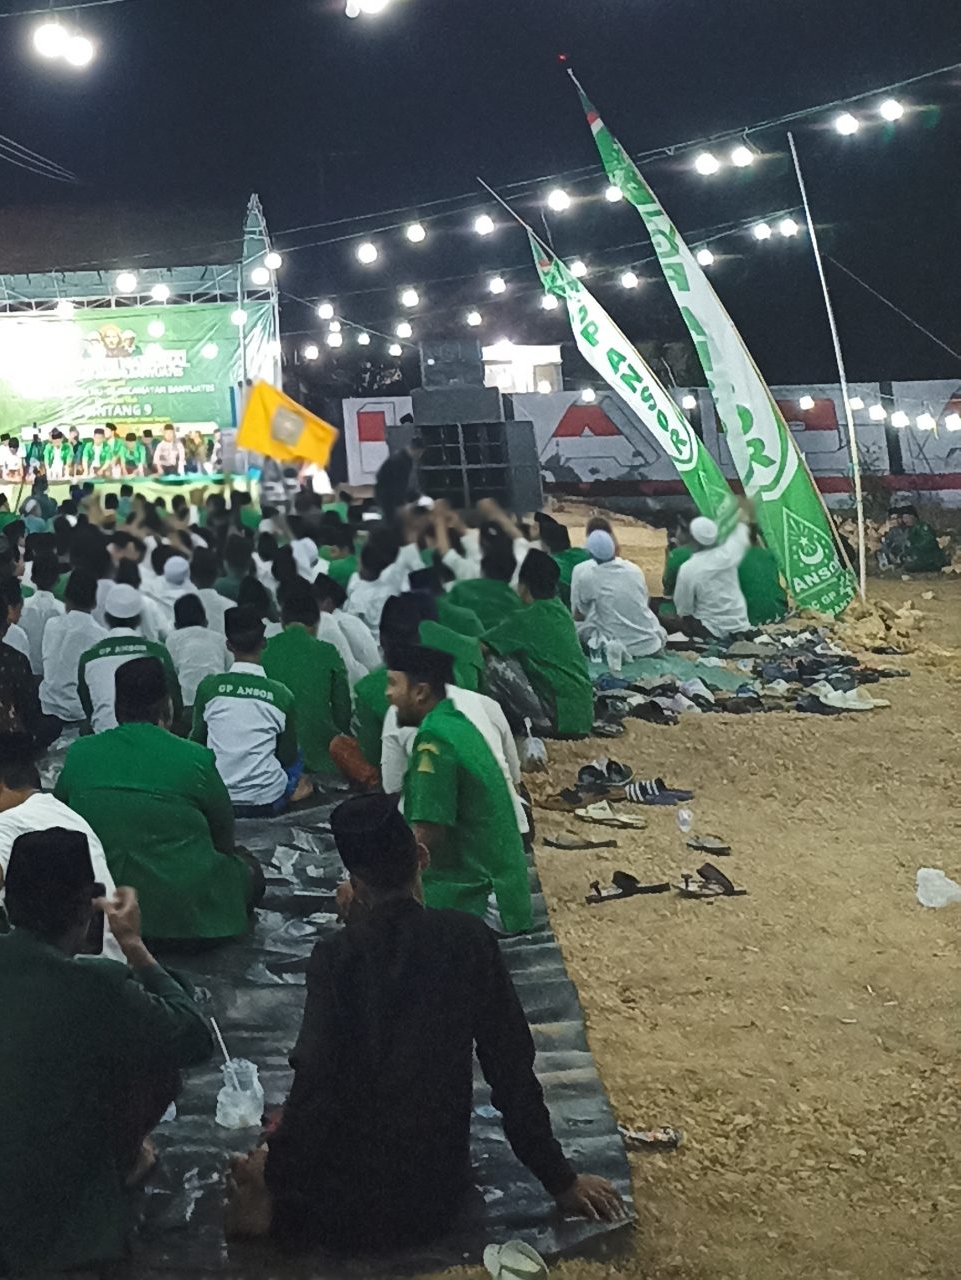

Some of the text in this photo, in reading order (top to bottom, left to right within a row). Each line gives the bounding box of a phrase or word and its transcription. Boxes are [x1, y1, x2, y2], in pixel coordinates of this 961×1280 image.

[143, 403, 153, 416] 9
[605, 347, 689, 457] ANSOR
[218, 684, 275, 701] GP ANSOR
